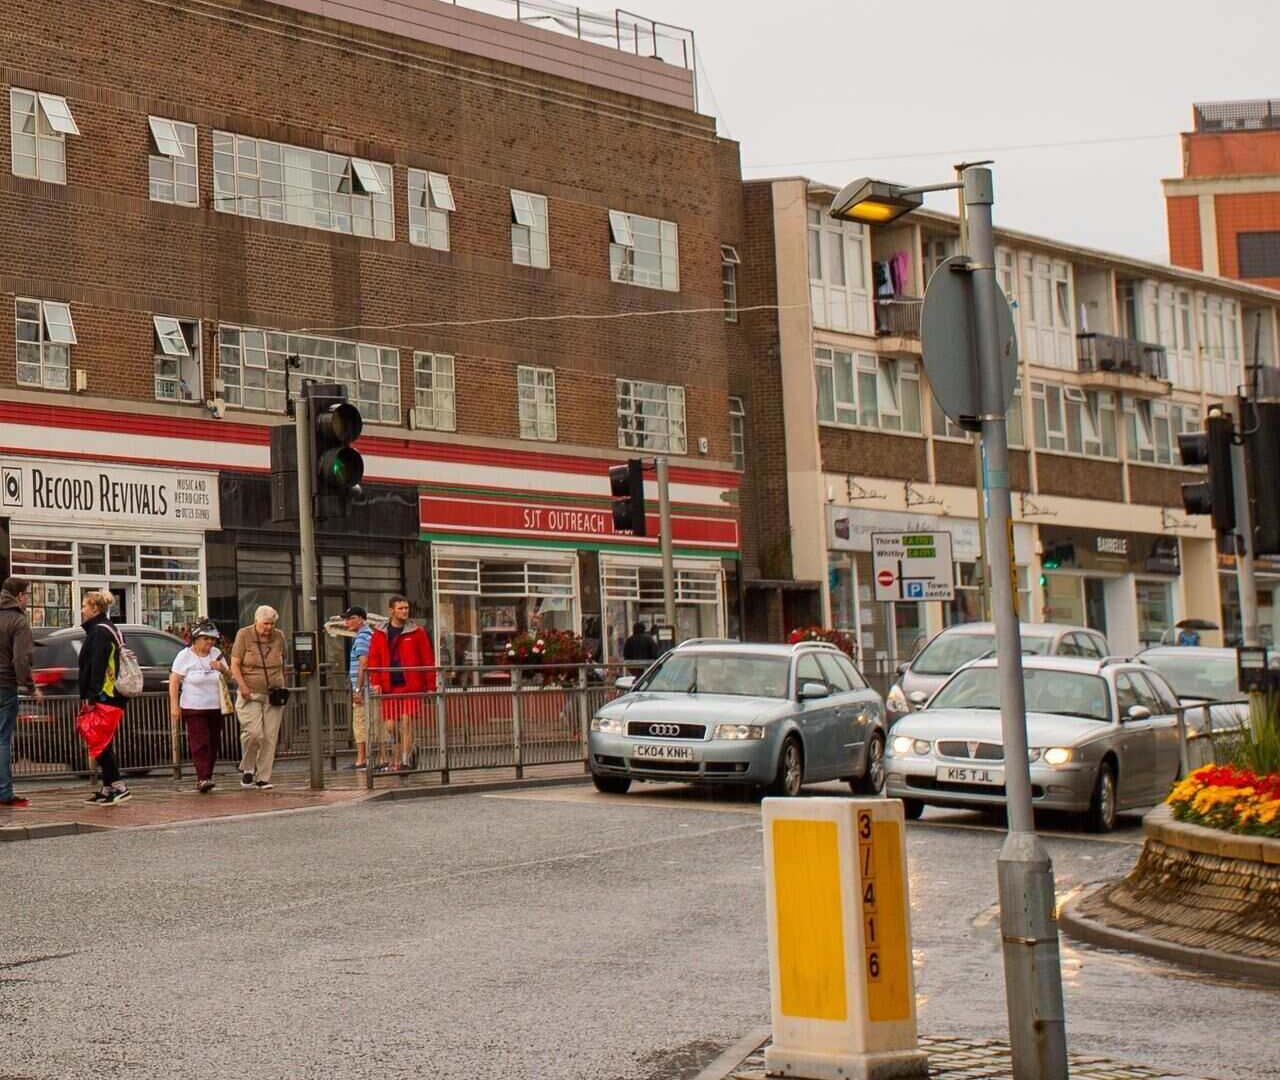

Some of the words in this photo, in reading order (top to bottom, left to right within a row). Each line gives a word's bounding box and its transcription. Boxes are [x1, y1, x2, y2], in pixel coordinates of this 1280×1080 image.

[176, 478, 193, 490] MUSIC
[194, 480, 206, 491] AND
[31, 469, 94, 512] RECORD
[98, 473, 168, 516] REVIVALS
[524, 509, 542, 529] SJT
[548, 511, 605, 533] OUTREACH
[875, 536, 900, 545] Thirsk
[1096, 536, 1128, 555] BARBELLE
[926, 581, 949, 590] Town
[637, 745, 664, 757] CK04
[666, 747, 688, 758] KNH
[969, 770, 993, 782] TJL
